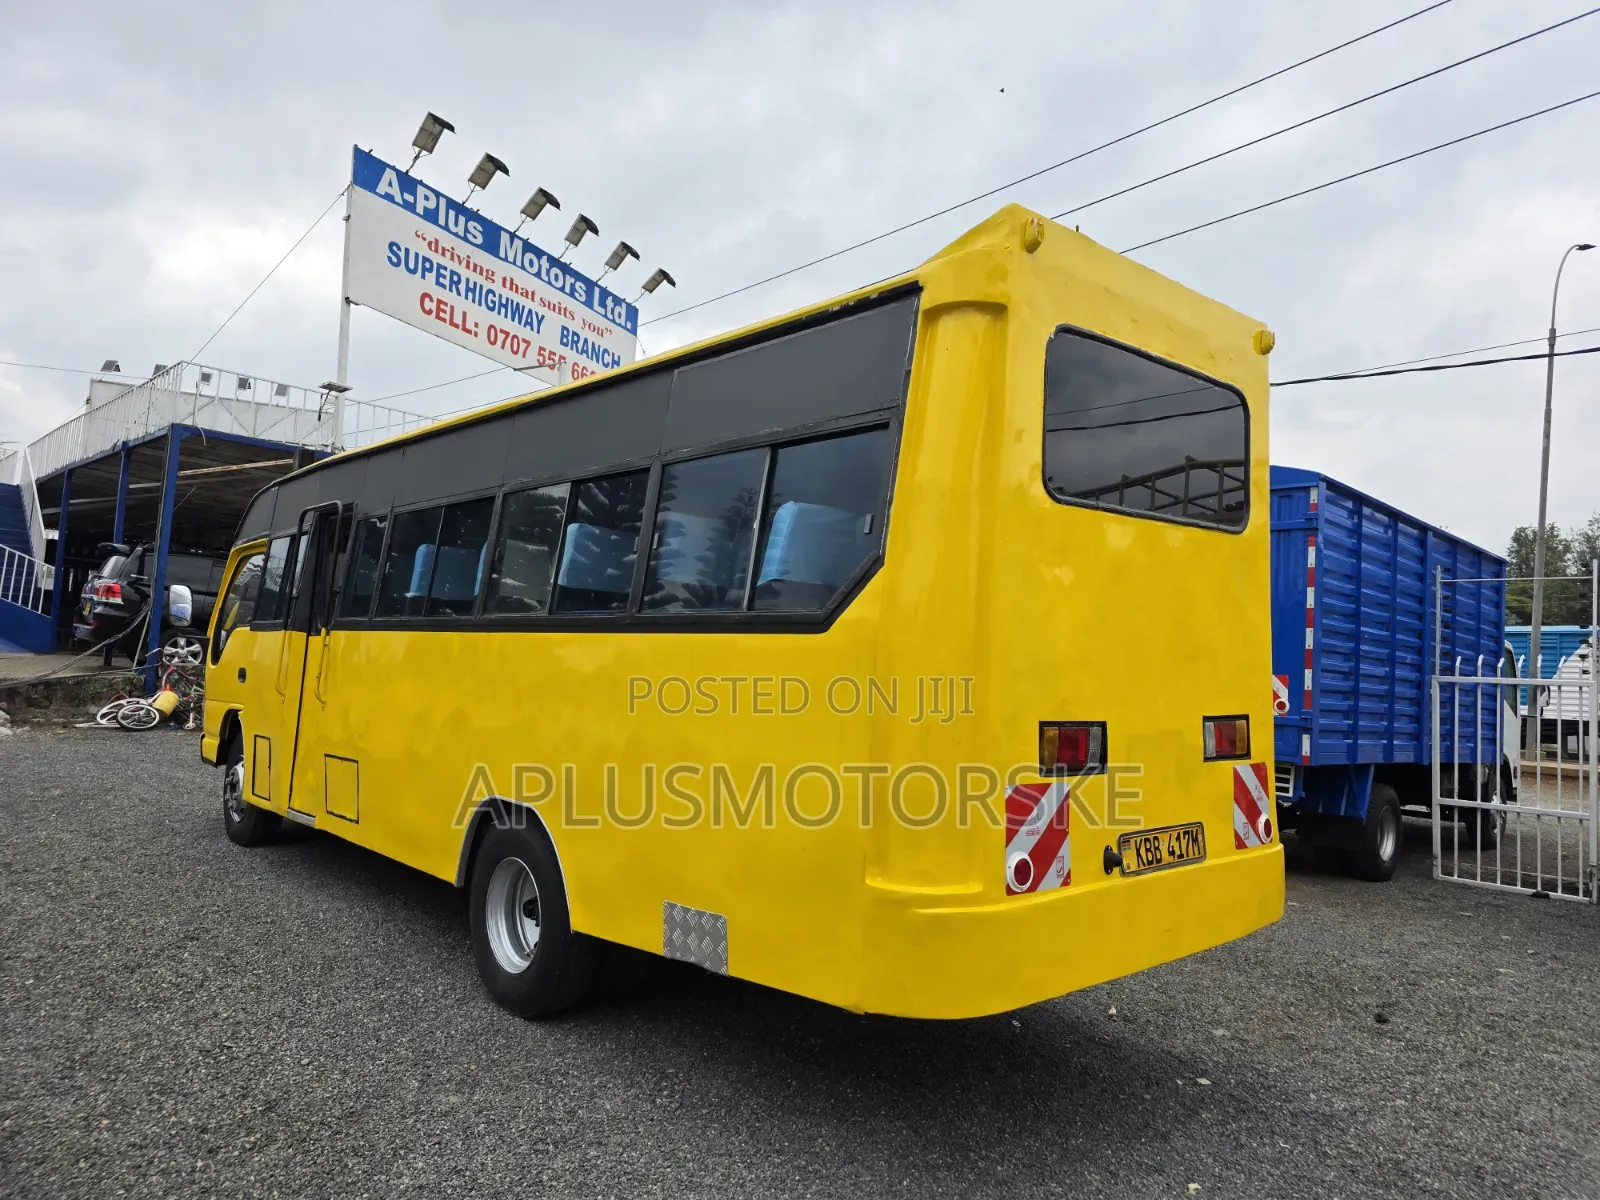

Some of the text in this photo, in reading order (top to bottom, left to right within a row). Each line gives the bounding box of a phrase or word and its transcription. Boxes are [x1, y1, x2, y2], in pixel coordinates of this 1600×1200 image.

[376, 168, 632, 329] A-Plus Motors Ltd.
[501, 275, 536, 303] that
[539, 295, 575, 322] suits
[419, 292, 480, 338] CELL:
[487, 323, 531, 360] 0707
[571, 361, 597, 381] 66
[560, 324, 621, 370] BRANCH
[1134, 828, 1202, 868] KBB 417M
